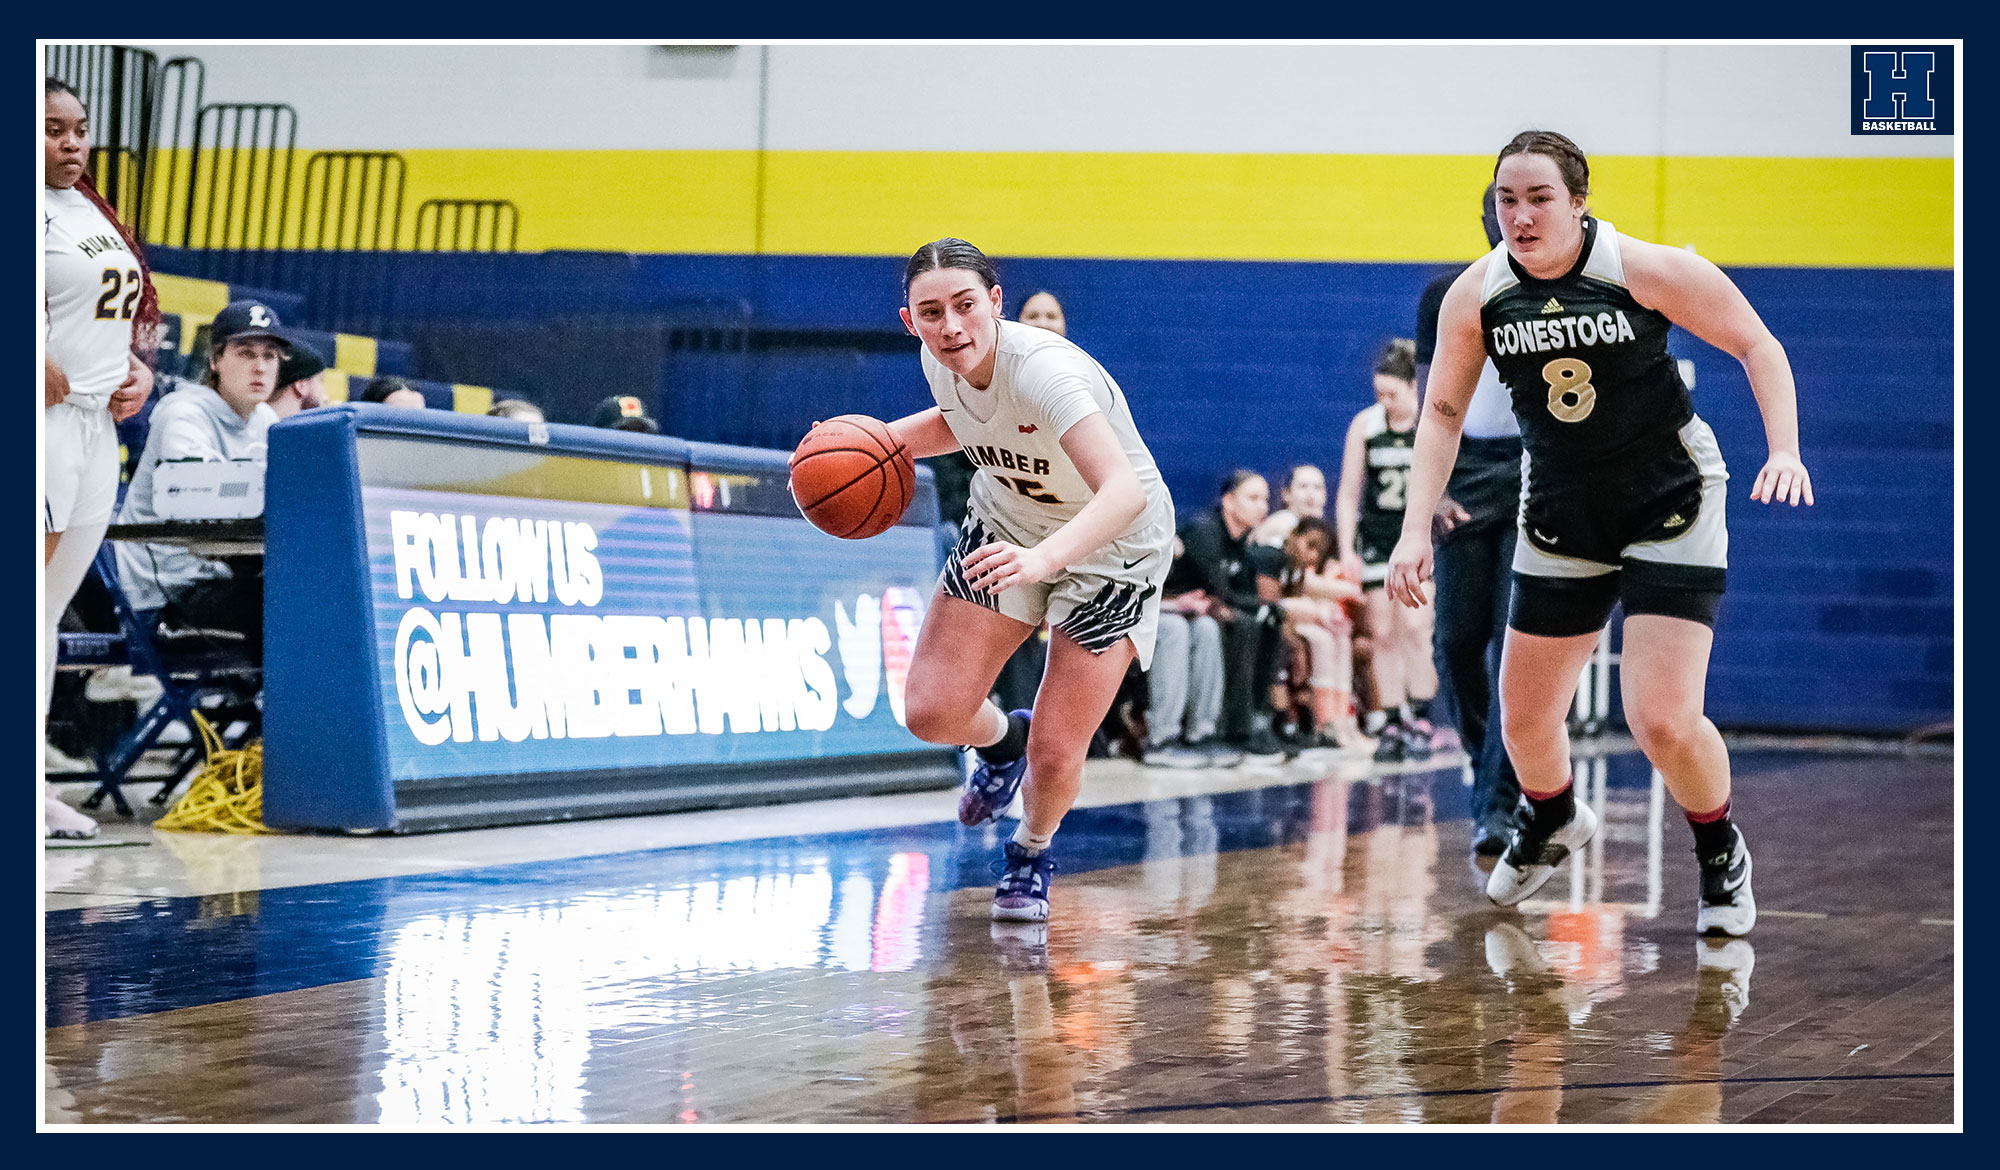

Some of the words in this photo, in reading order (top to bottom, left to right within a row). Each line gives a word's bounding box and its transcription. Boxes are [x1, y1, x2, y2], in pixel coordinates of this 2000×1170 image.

[94, 267, 140, 320] 22
[249, 305, 271, 328] L
[1492, 310, 1636, 356] CONESTOGA
[1542, 357, 1597, 423] 8
[963, 445, 1050, 475] UMBER
[390, 510, 549, 605] FOLLOW
[548, 520, 604, 607] US
